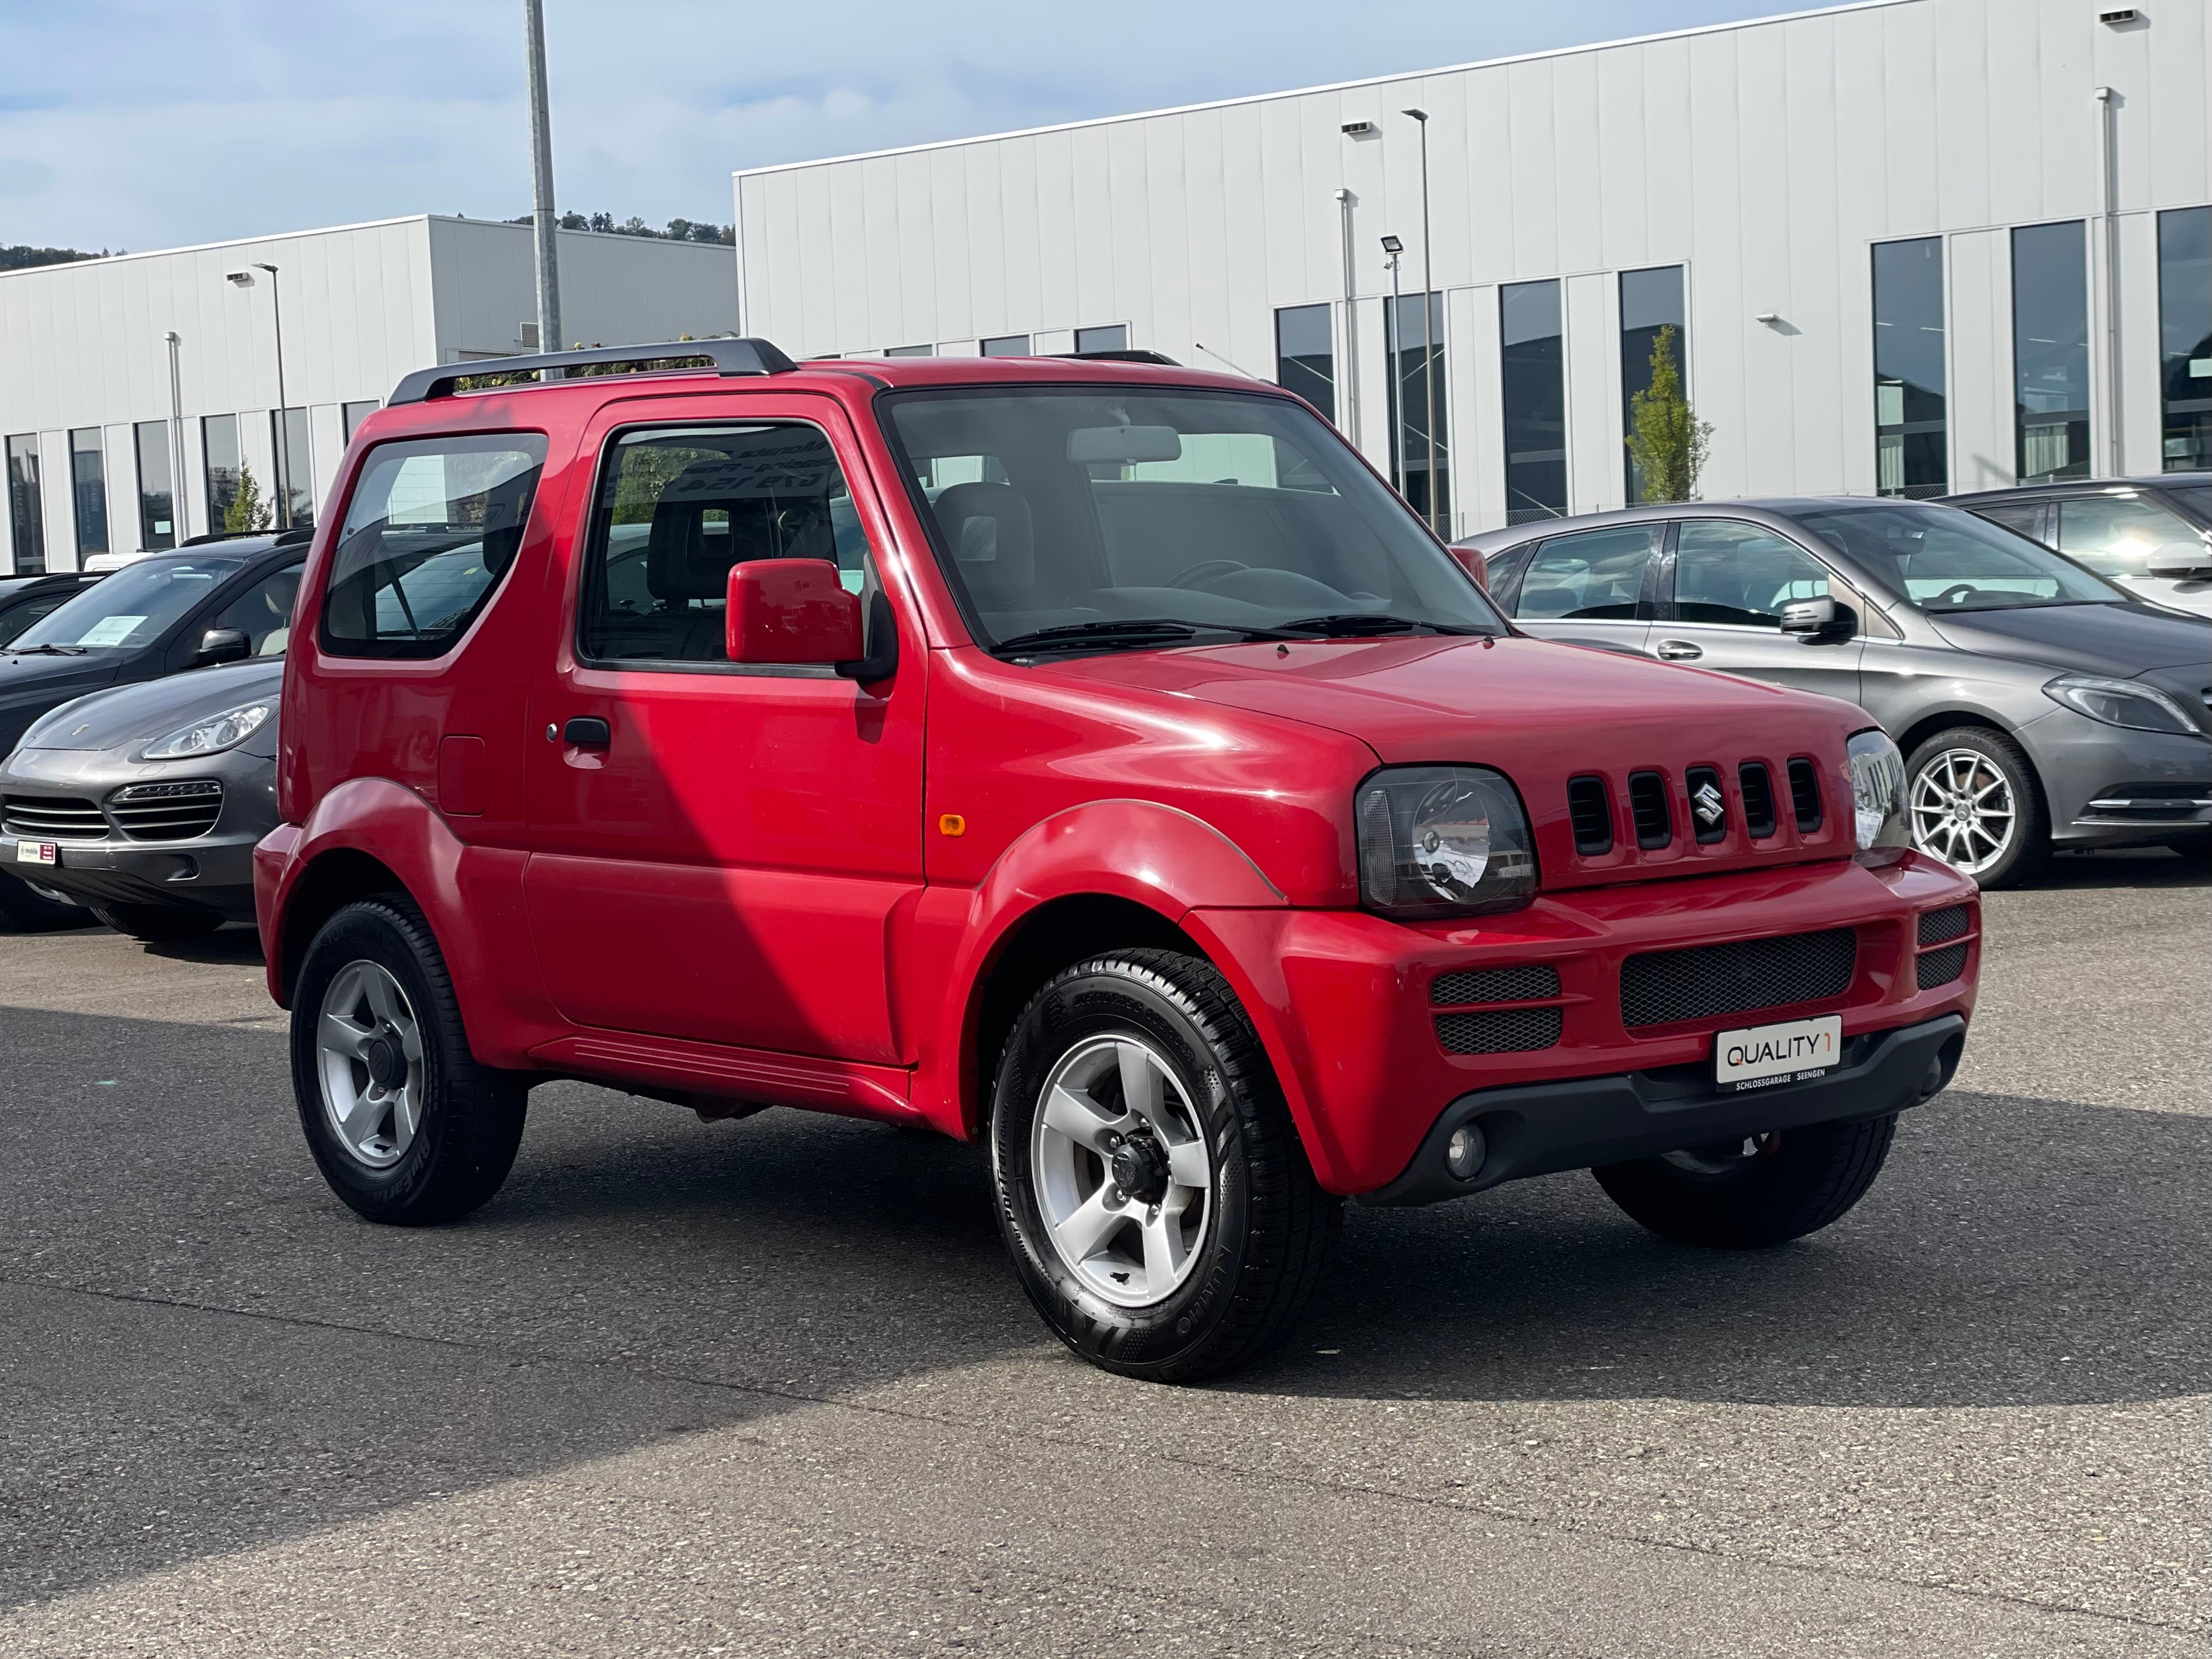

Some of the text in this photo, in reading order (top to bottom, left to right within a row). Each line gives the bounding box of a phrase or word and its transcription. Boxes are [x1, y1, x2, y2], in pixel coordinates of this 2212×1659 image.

[1958, 735, 1991, 748] POLARIS
[1736, 1068, 1825, 1091] SCHLOSSGARAGE SEENGEN
